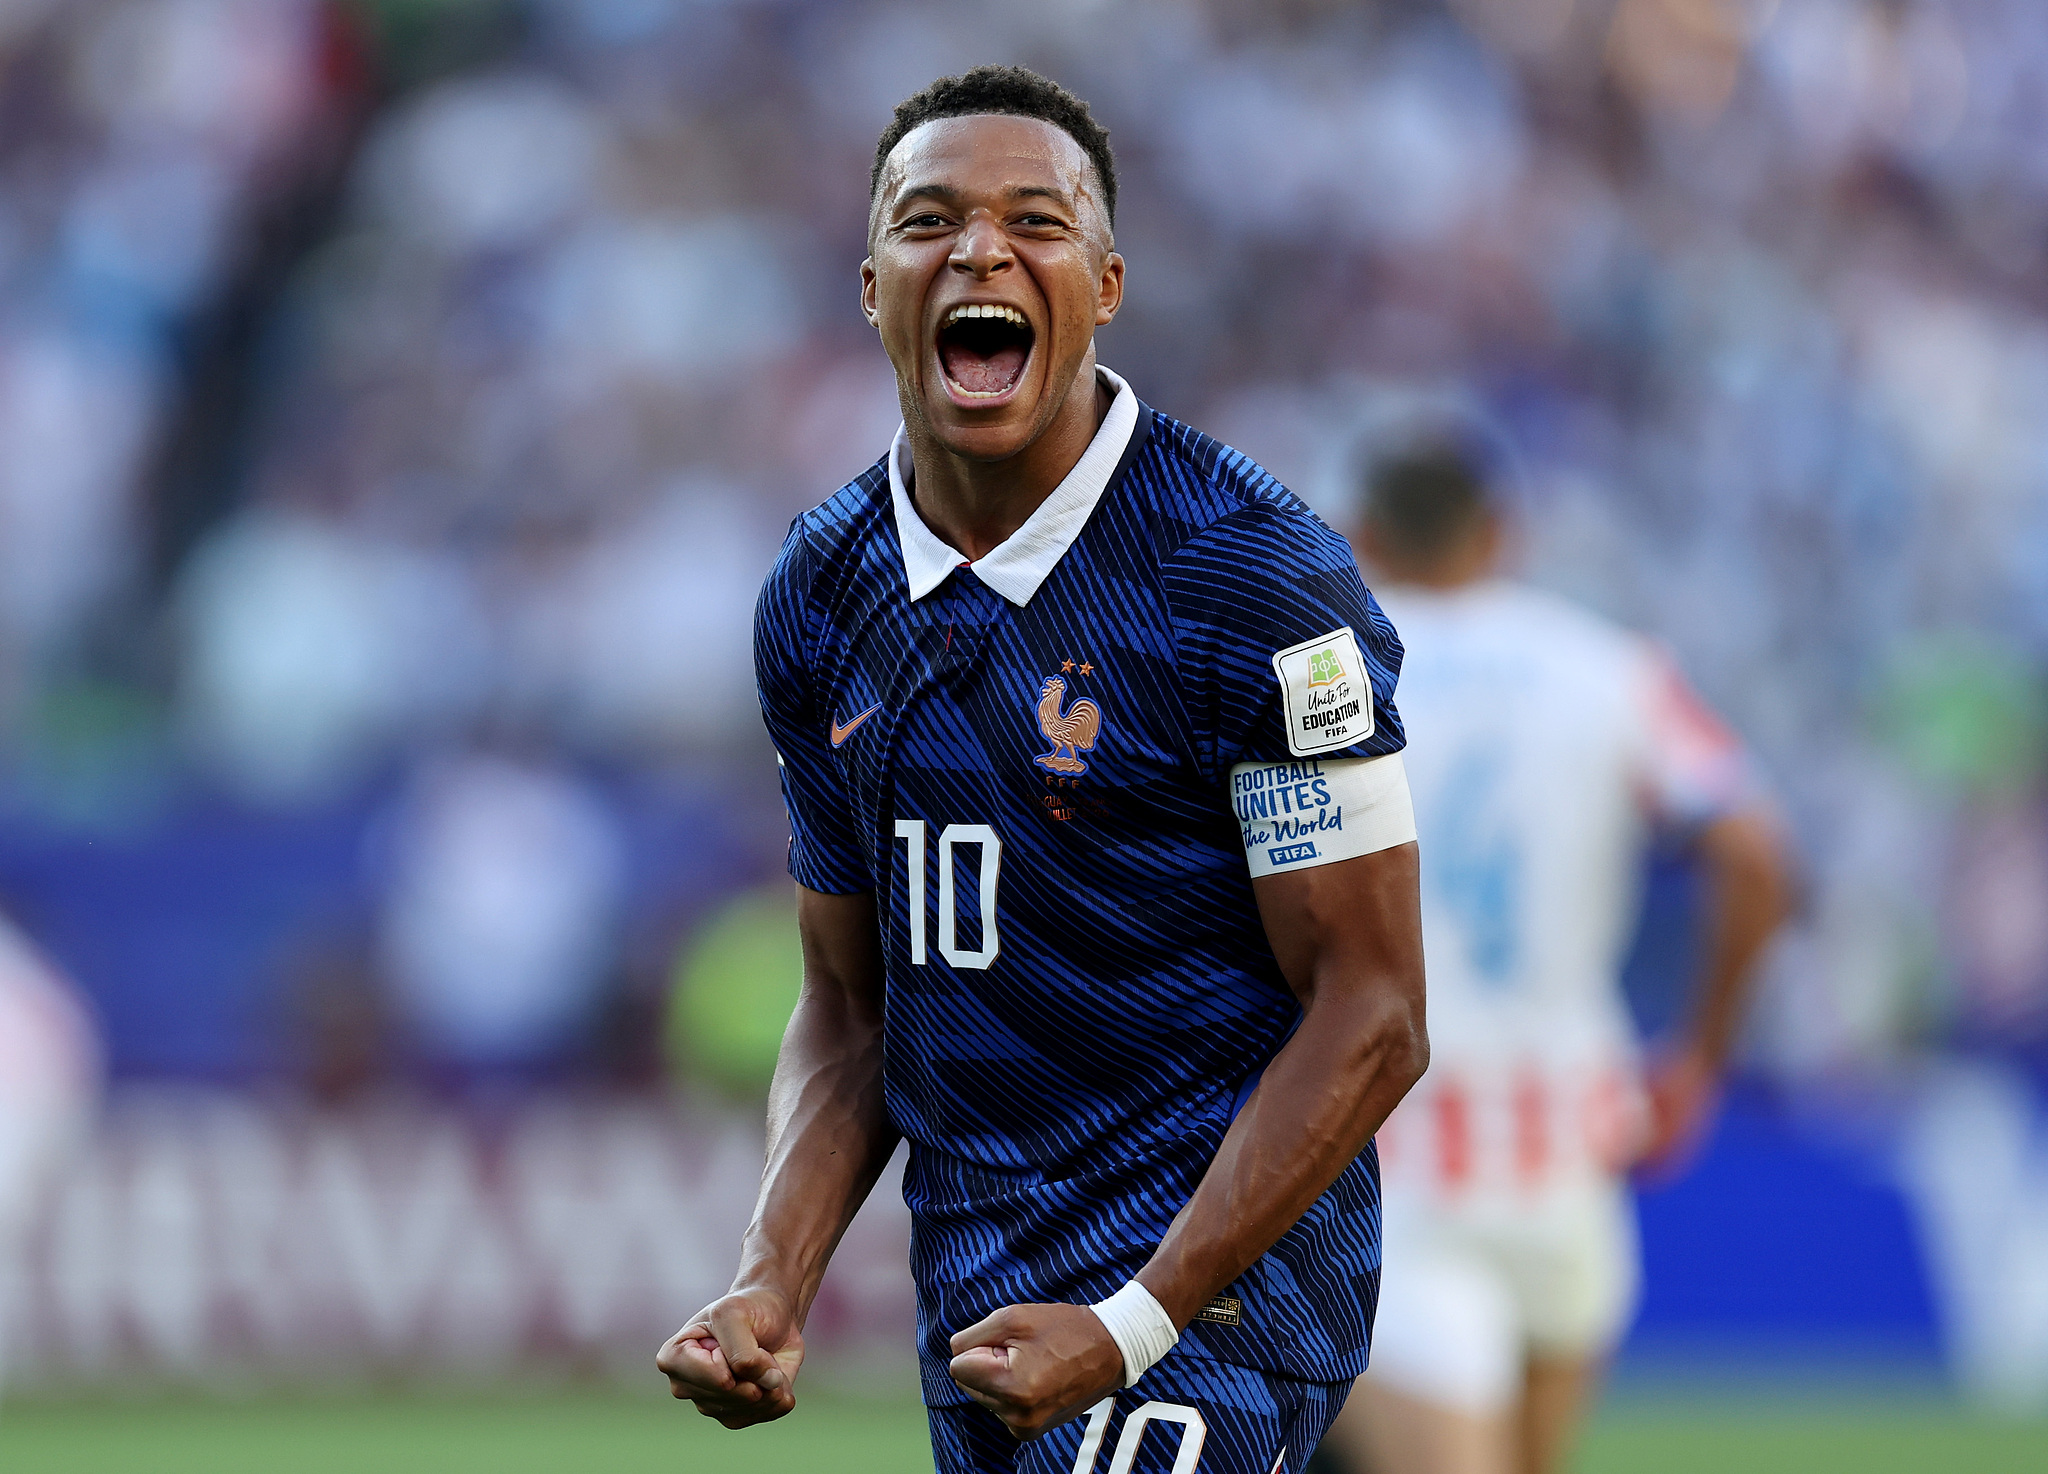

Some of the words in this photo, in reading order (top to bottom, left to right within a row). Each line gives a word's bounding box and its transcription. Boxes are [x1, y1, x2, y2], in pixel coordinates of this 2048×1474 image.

[1307, 689, 1338, 711] Unite
[1336, 682, 1351, 702] For
[1302, 699, 1360, 731] EDUCATION
[1325, 725, 1348, 738] FIFA
[1234, 761, 1325, 794] FOOTBALL
[1236, 778, 1331, 822] UNITES
[1243, 823, 1270, 848] the
[1270, 806, 1343, 842] World
[1272, 844, 1315, 863] FIFA
[895, 819, 1003, 970] 10
[1072, 1396, 1207, 1474] 10
